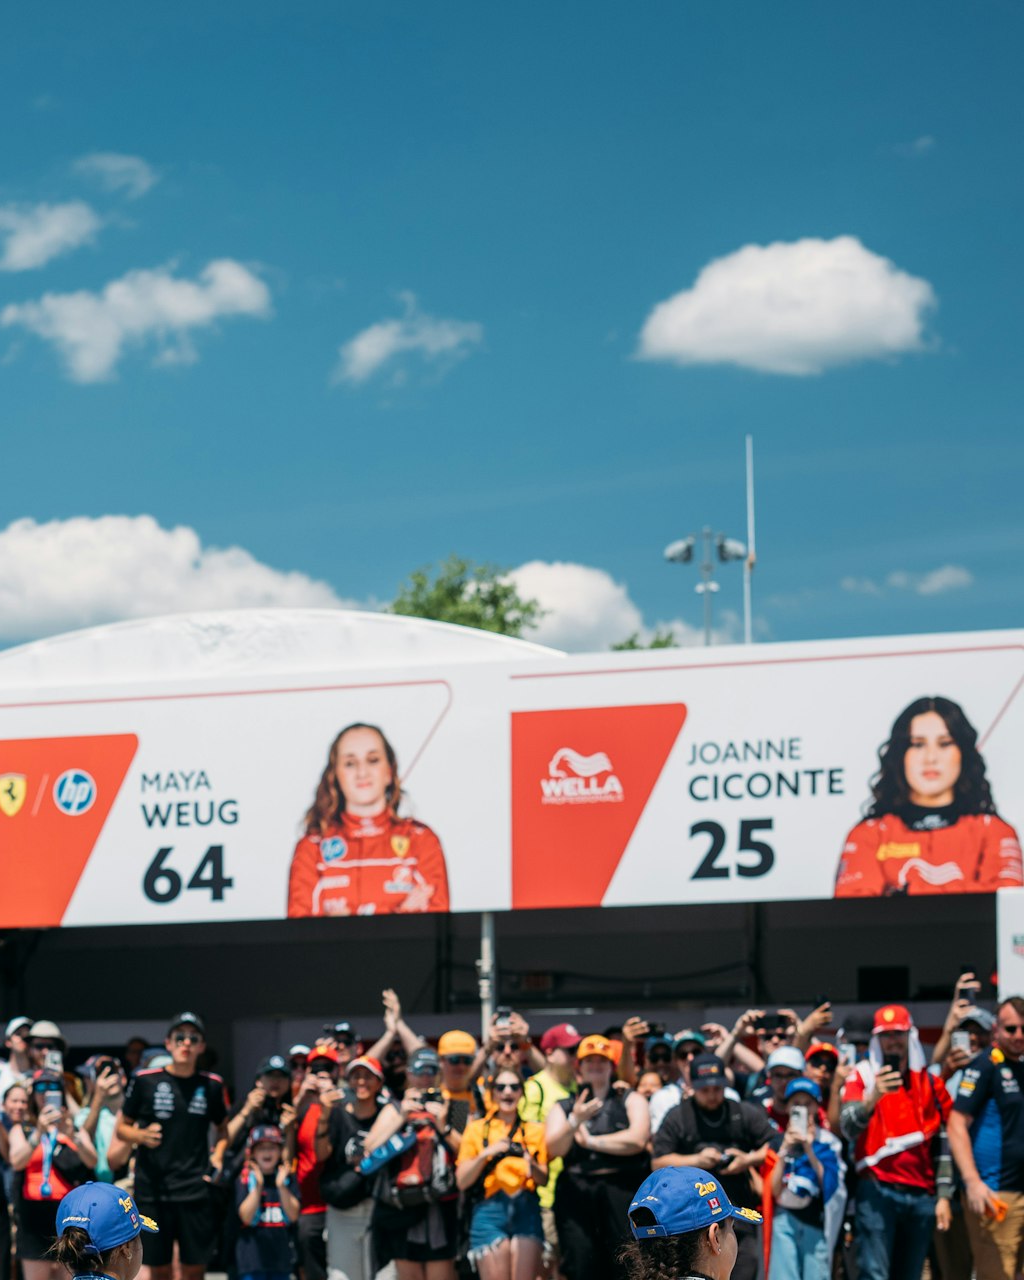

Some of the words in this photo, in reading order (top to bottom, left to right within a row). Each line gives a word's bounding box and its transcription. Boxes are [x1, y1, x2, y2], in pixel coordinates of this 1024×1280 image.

[687, 737, 802, 766] JOANNE
[140, 770, 212, 793] MAYA
[539, 775, 624, 797] WELLA
[688, 769, 844, 801] CICONTE
[141, 800, 240, 828] WEUG
[688, 818, 775, 881] 25
[142, 845, 234, 905] 64
[695, 1181, 717, 1197] 2ND
